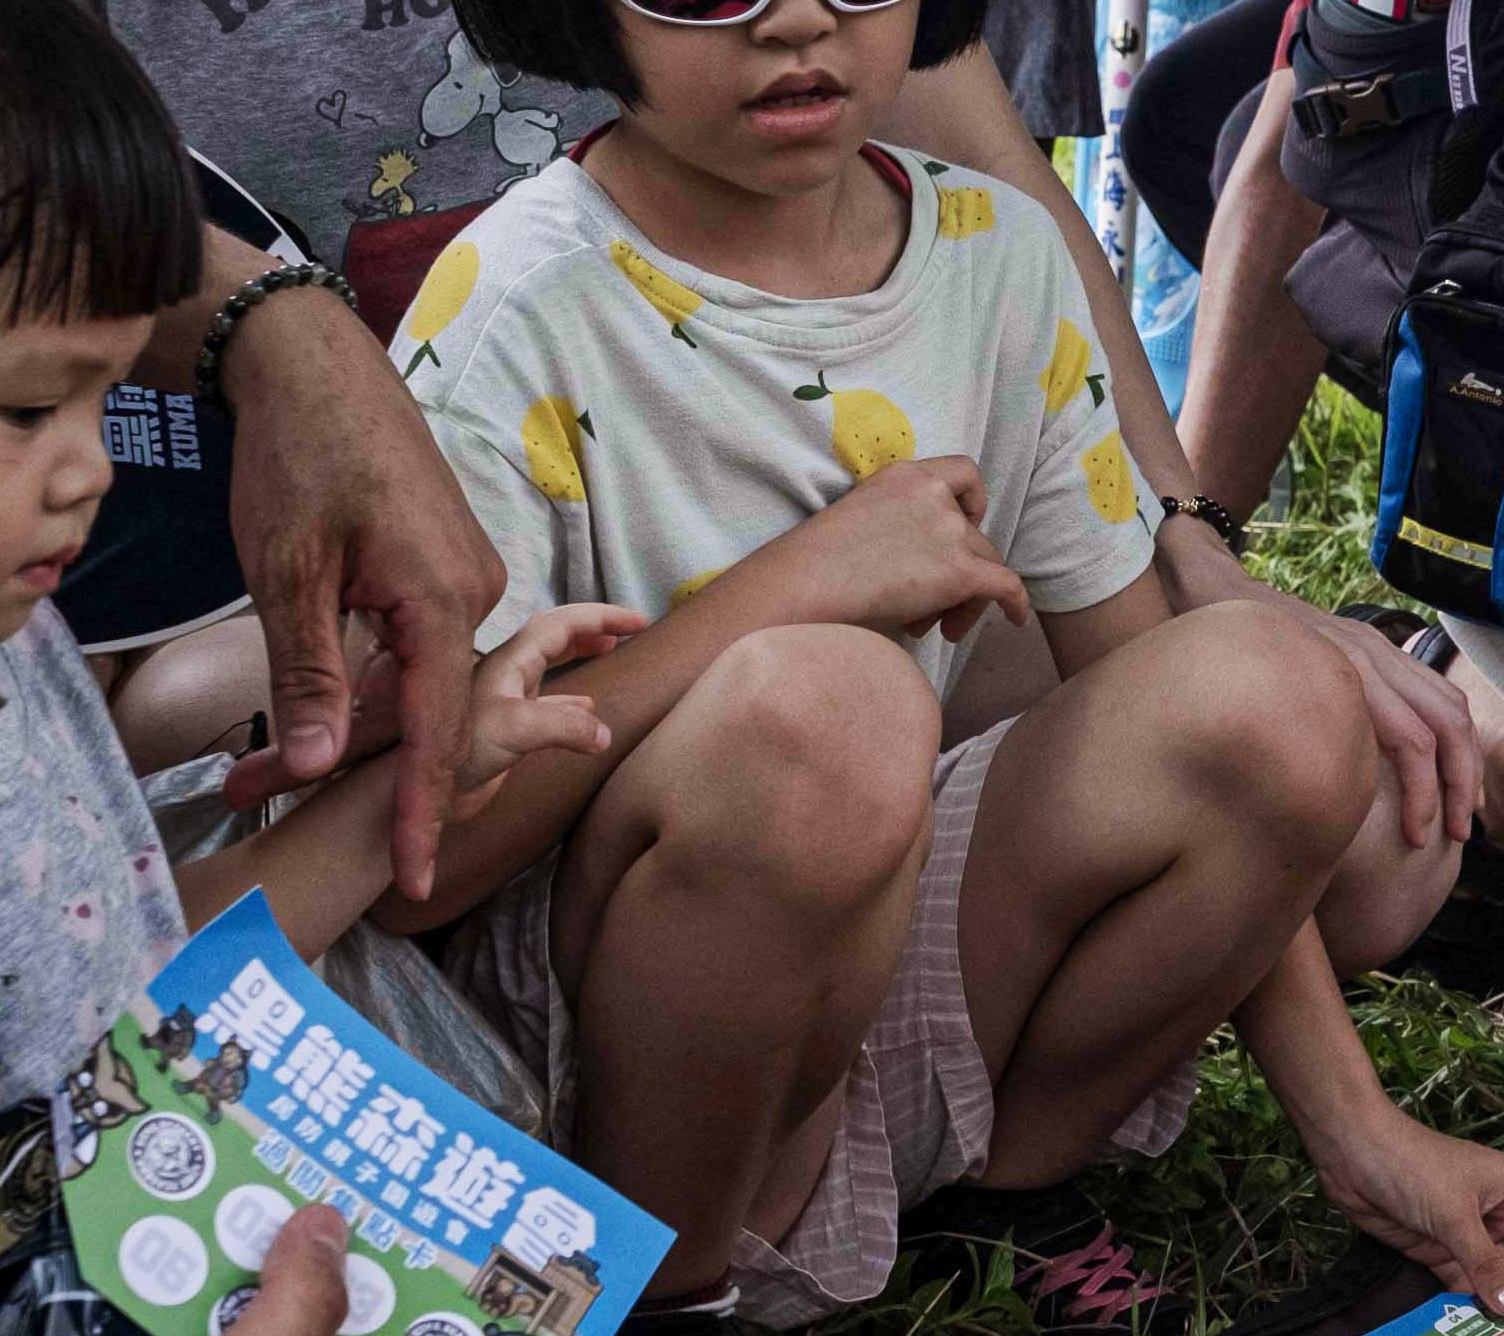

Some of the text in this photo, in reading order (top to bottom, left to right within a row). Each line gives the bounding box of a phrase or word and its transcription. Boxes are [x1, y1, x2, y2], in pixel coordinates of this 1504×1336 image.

[165, 394, 202, 470] KUMA
[194, 957, 597, 1271] 黑熊森遊會
[251, 1125, 440, 1270] 過關集點卡
